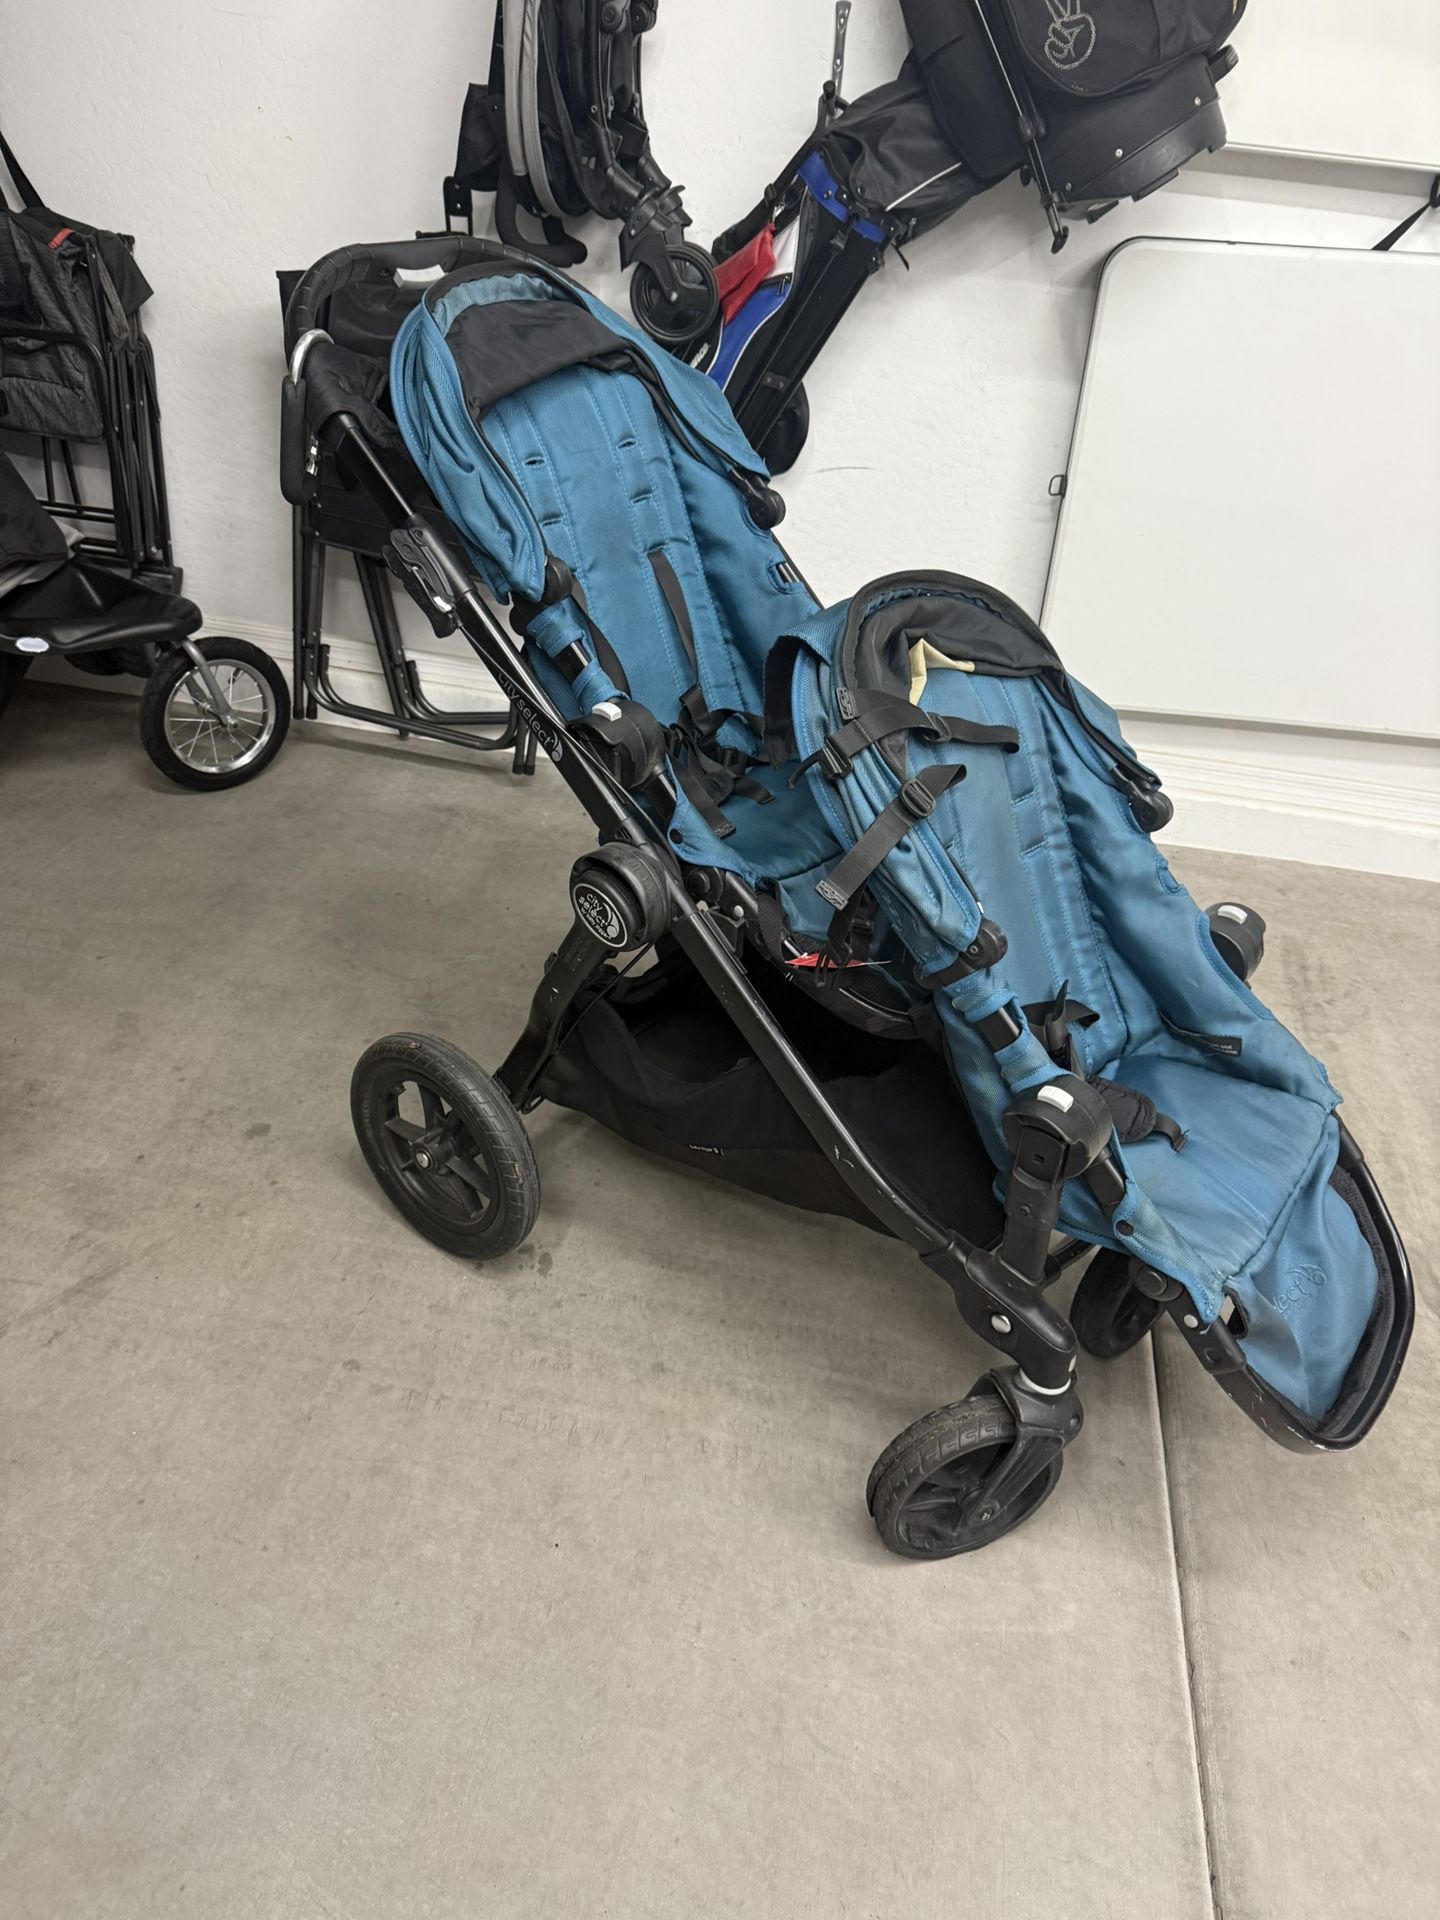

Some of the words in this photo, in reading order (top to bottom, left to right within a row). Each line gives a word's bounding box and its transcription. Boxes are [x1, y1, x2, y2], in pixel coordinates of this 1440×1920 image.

[498, 672, 520, 700] city
[516, 699, 552, 747] select
[578, 896, 606, 928] select
[586, 893, 604, 912] city
